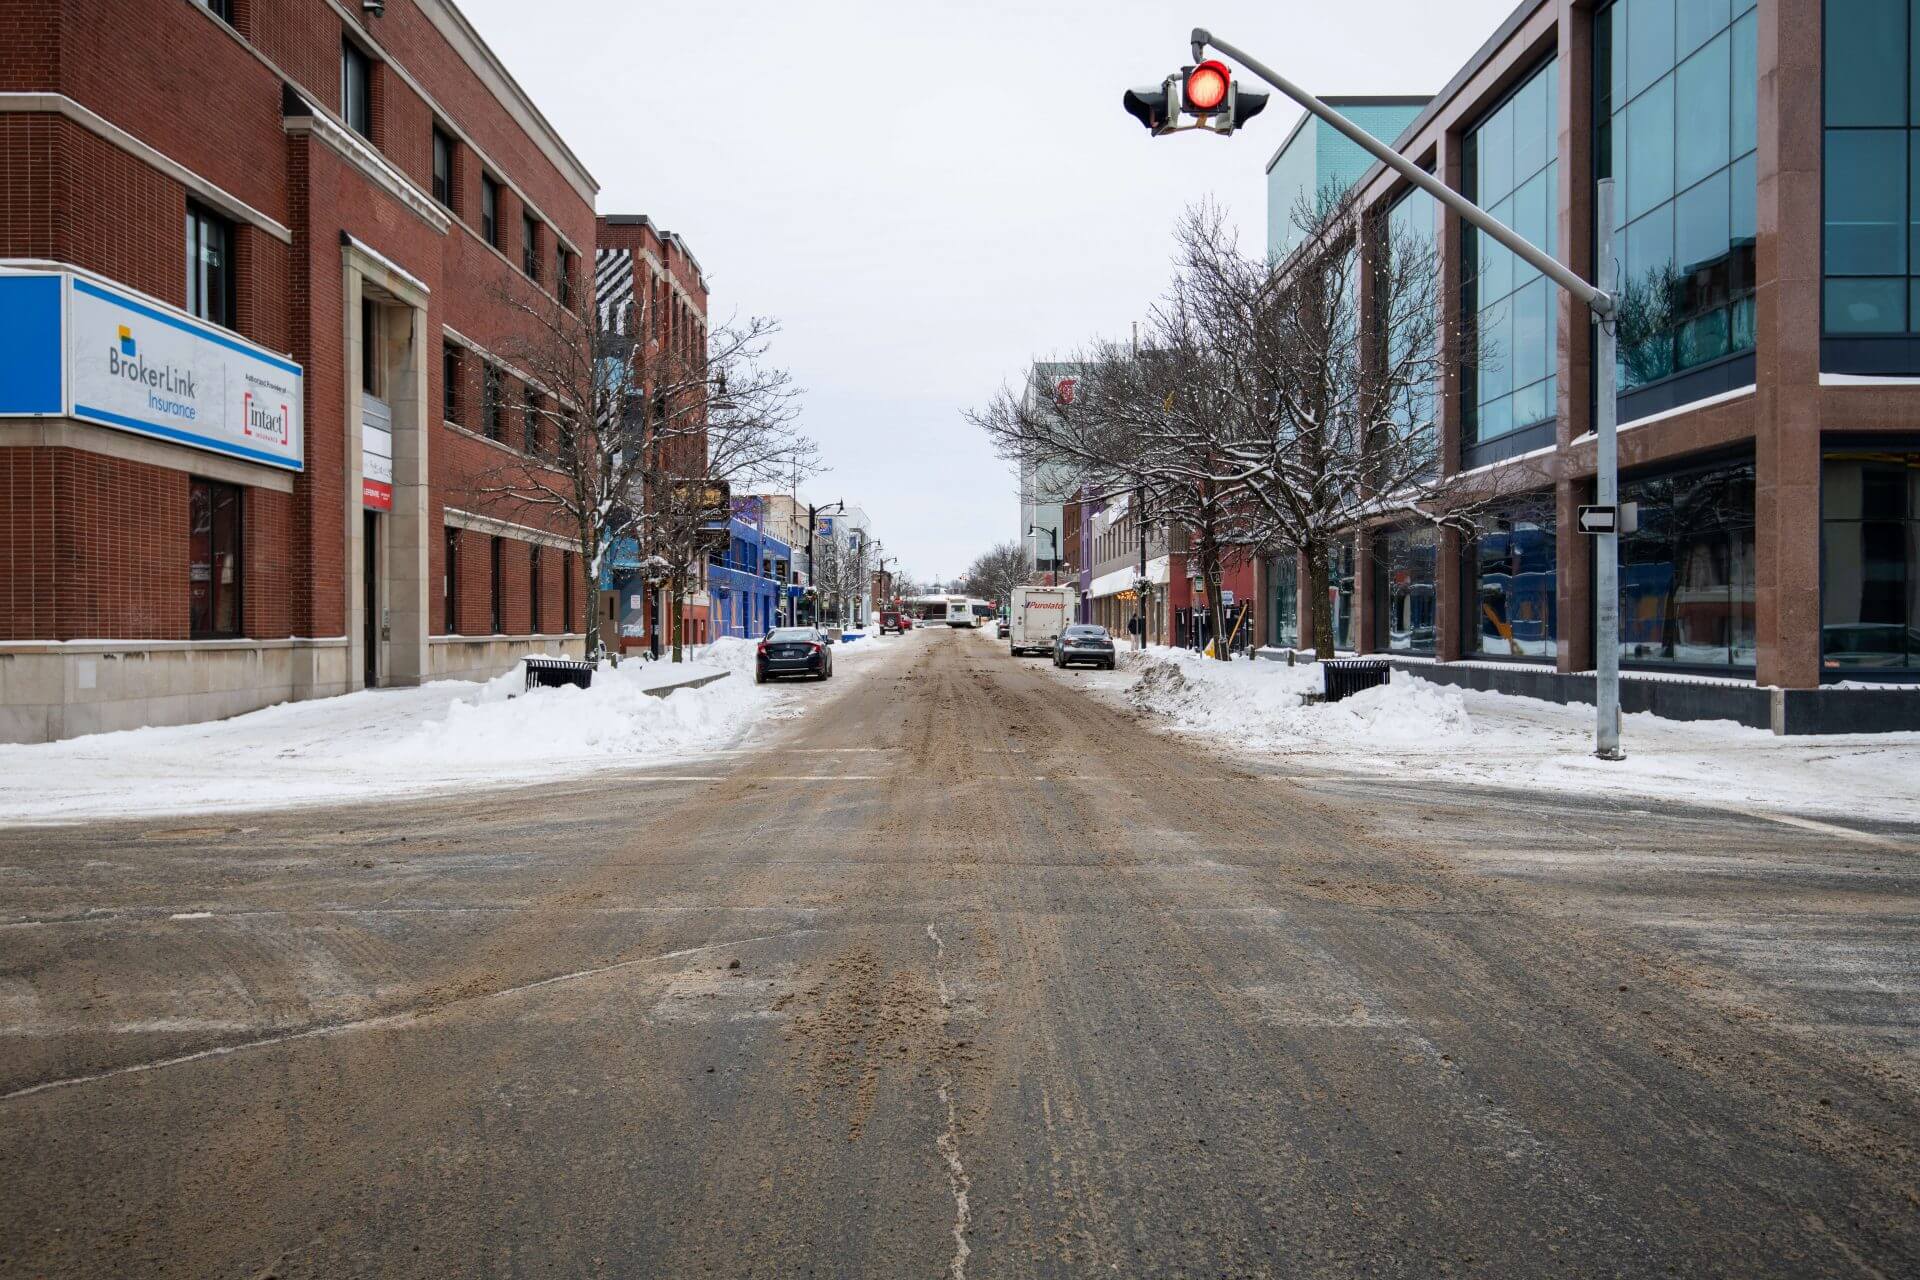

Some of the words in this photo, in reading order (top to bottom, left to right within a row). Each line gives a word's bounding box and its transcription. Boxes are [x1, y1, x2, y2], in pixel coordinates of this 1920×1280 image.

[110, 346, 196, 399] BrokerLink
[149, 389, 196, 420] Insurance
[251, 402, 283, 434] intact
[1029, 601, 1066, 609] Purolator
